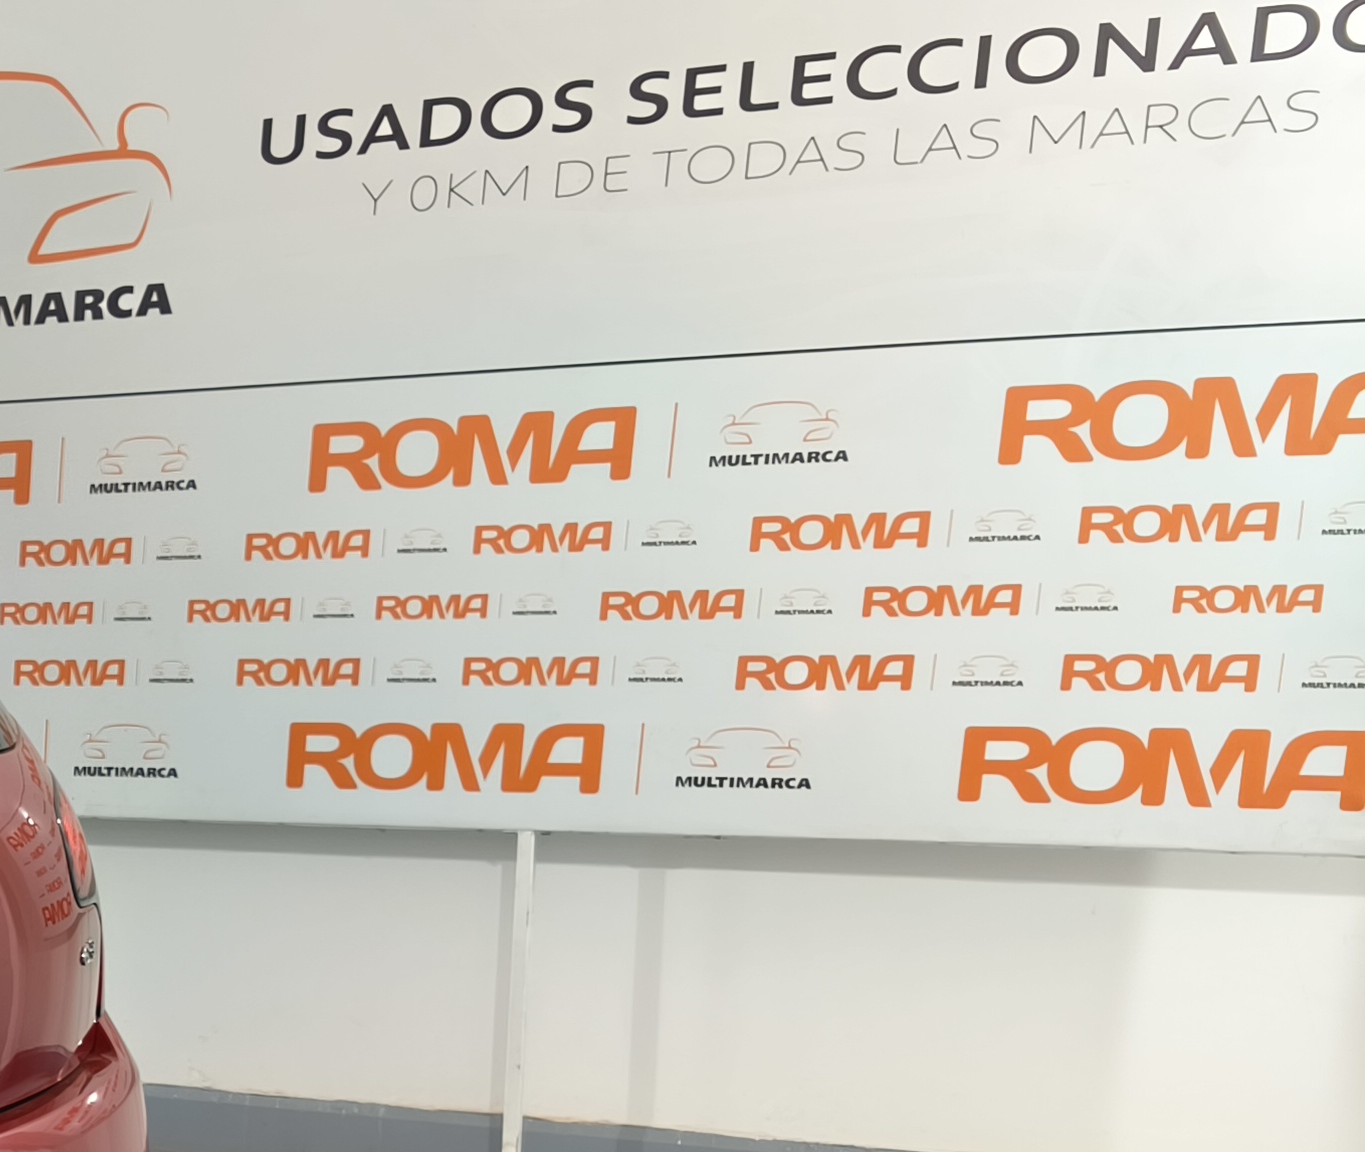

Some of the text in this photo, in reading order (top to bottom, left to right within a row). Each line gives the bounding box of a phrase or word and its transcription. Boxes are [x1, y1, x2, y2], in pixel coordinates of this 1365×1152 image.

[260, 79, 595, 165] USADOS
[362, 179, 394, 216] Y
[555, 154, 631, 199] DE
[652, 131, 866, 188] TODAS
[893, 118, 1001, 166] LAS
[1029, 89, 1321, 154] MARCAS
[307, 406, 849, 495] ROMA MULTIMARCA
[89, 478, 198, 495] MULTIMARCA
[472, 521, 614, 557] ROMA
[749, 511, 1042, 554] ROMA MULTIMARCA
[1077, 501, 1281, 546] ROMA
[19, 537, 134, 569] ROMA
[244, 529, 372, 563] ROMA
[187, 597, 292, 625] ROMA
[375, 593, 490, 622] ROMA
[599, 588, 746, 622] ROMA
[862, 584, 1023, 620] ROMA
[1172, 584, 1325, 615] ROMA
[14, 659, 127, 688] ROMA
[236, 657, 362, 688] ROMA
[462, 656, 601, 688] ROMA
[735, 654, 916, 693] ROMA
[1060, 653, 1262, 695] ROMA
[73, 766, 179, 779] MULTIMARCA
[285, 722, 813, 795] ROMA MULTIMARCA
[957, 726, 1365, 814] ROMA
